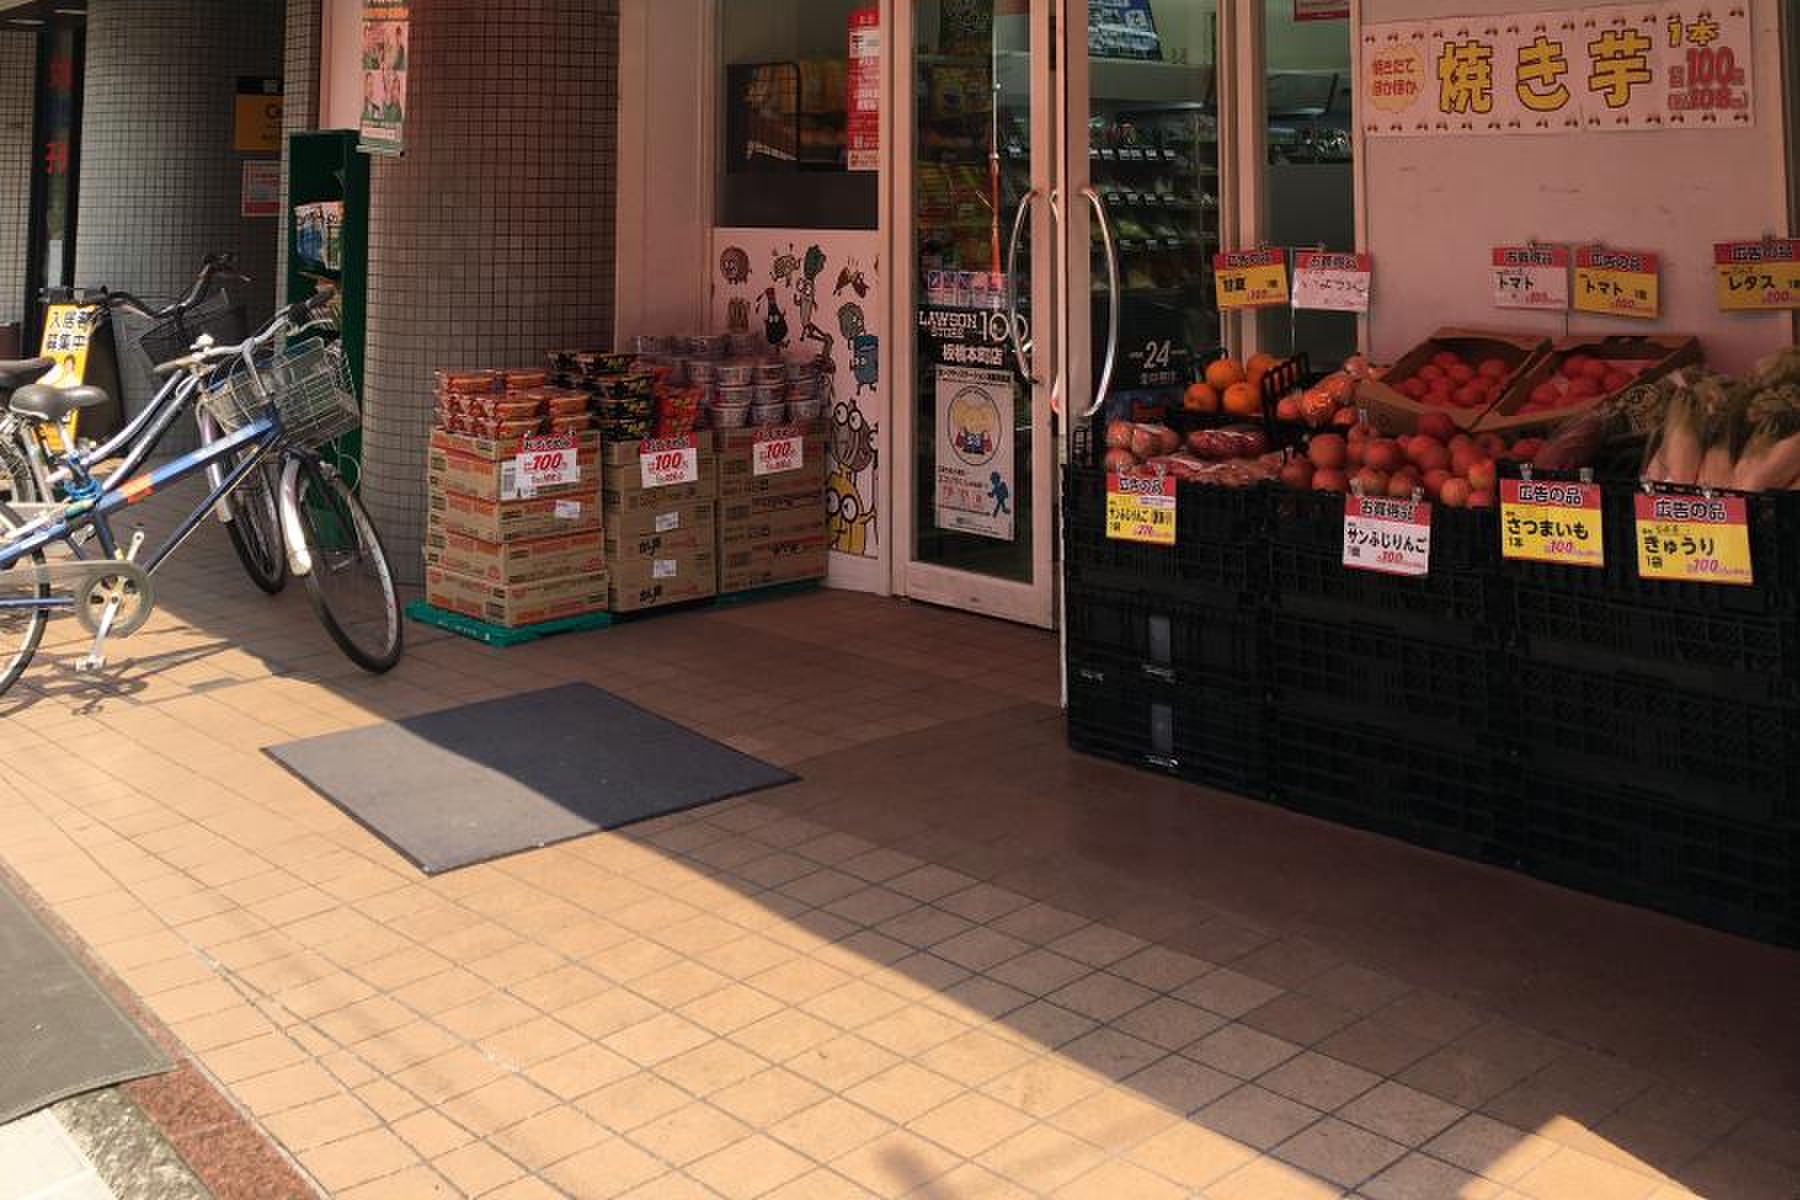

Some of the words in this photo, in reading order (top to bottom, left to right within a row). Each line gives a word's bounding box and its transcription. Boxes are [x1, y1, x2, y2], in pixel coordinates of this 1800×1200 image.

[1436, 30, 1653, 114] 焼き芋
[1498, 275, 1535, 290] トマト
[1585, 279, 1624, 297] トマト
[1728, 275, 1775, 291] レタス
[919, 311, 977, 329] LAWSON
[1142, 339, 1171, 368] 24
[766, 441, 790, 459] 100
[531, 452, 563, 471] 100
[655, 452, 683, 471] 100
[1519, 484, 1583, 506] 広告の品
[1655, 499, 1727, 521] 広告の品
[1506, 516, 1589, 540] さつまいも
[1346, 527, 1427, 553] サンふじりんご
[1643, 536, 1715, 557] きゅうり
[1693, 559, 1719, 573] 100
